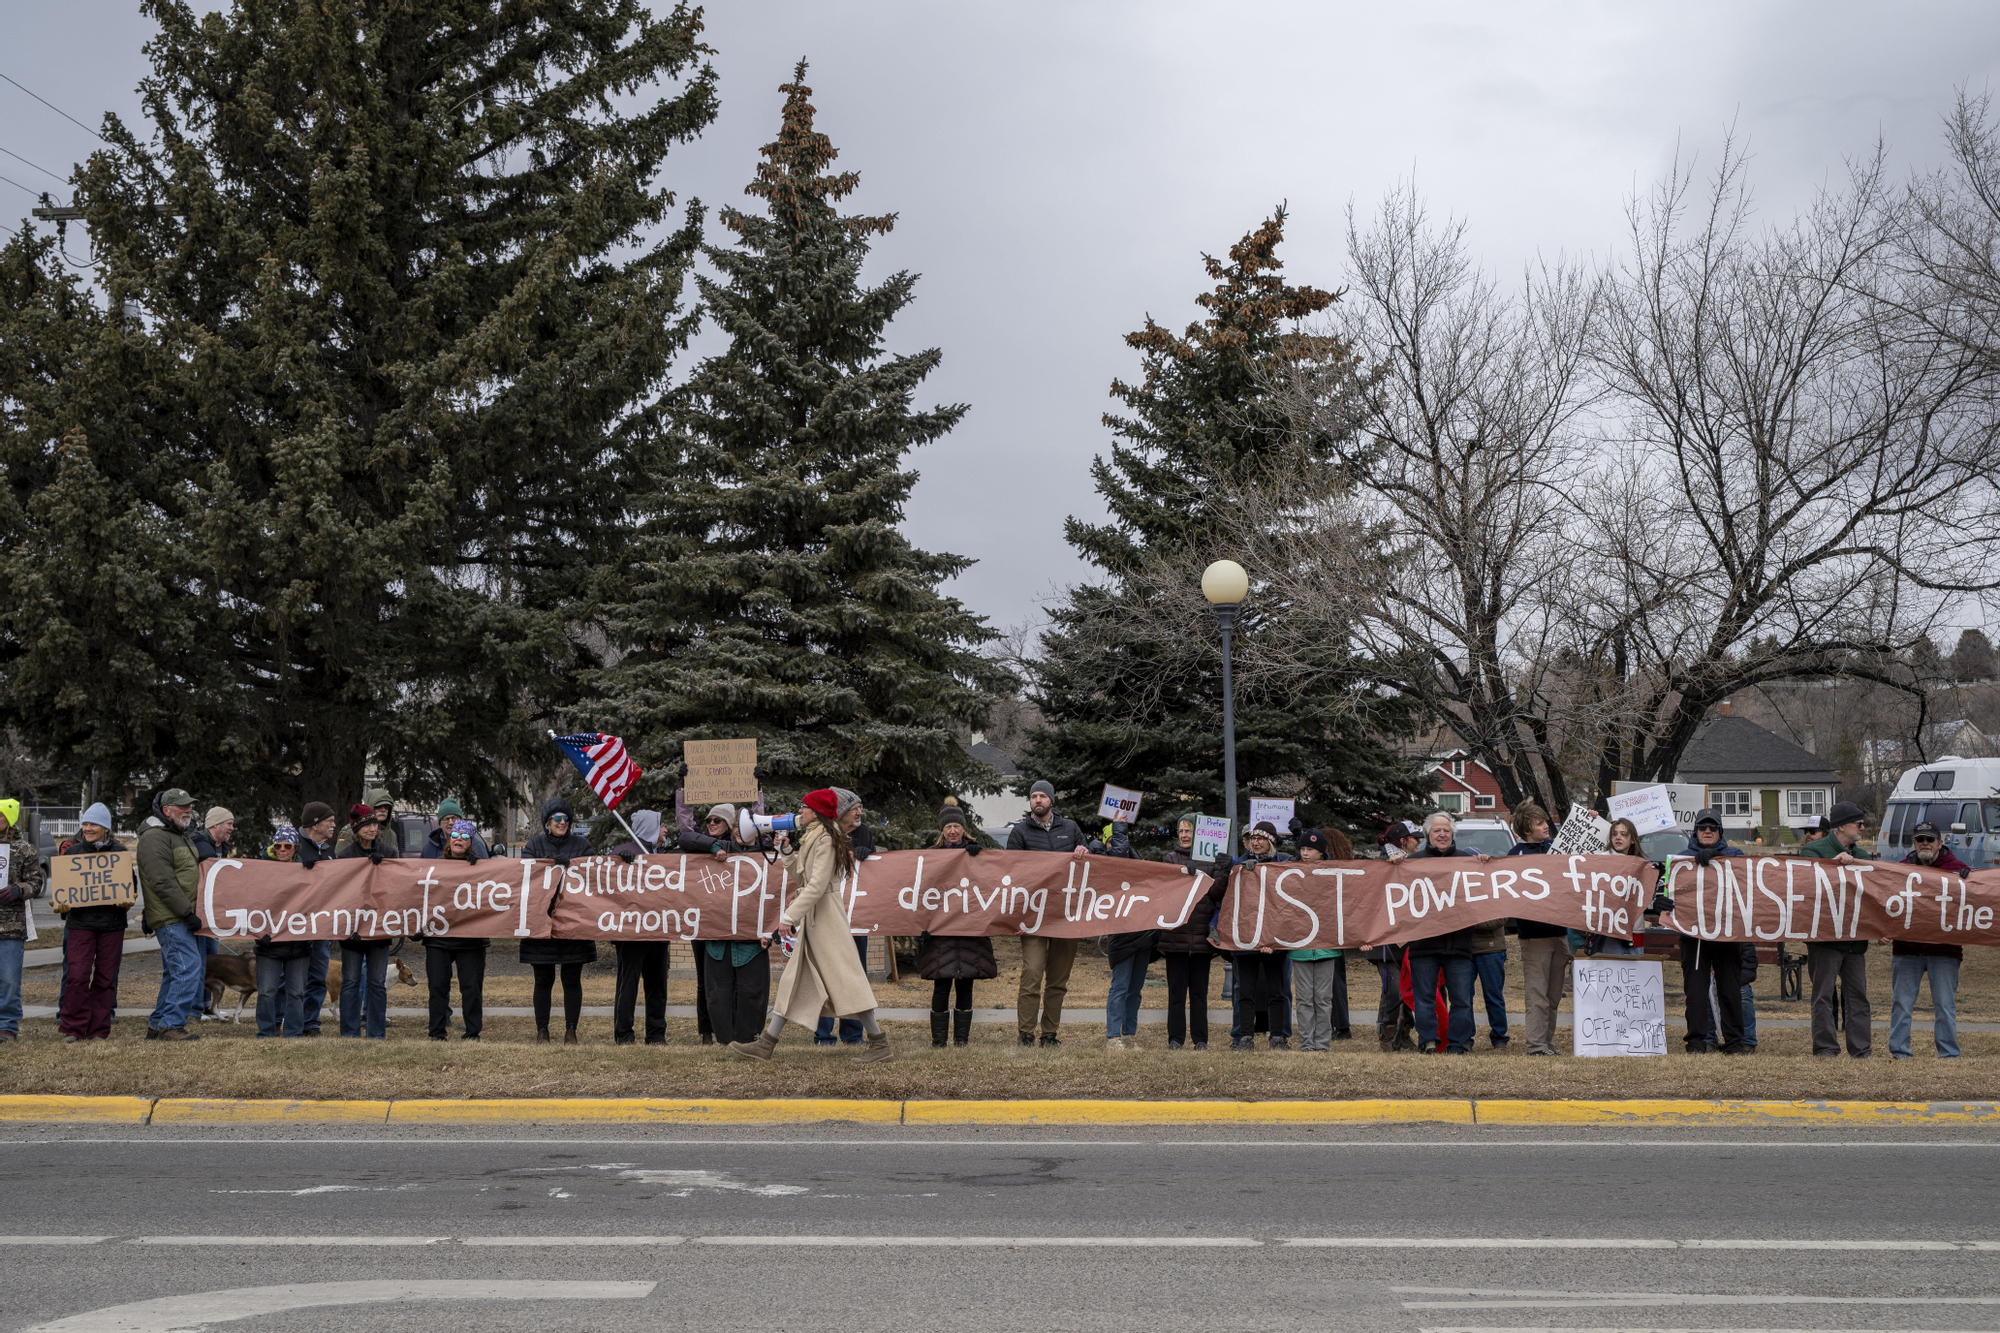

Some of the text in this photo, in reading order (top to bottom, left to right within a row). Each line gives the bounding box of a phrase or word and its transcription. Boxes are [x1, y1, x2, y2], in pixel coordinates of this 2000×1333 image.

[686, 788, 757, 801] ELECTED PRESIDENT?
[1105, 797, 1138, 812] ICE OUT
[1207, 818, 1226, 827] Prefer
[1197, 828, 1228, 838] CRUSHED
[1562, 825, 1581, 842] FACES
[1567, 819, 1606, 851] SHOW THEIR
[1200, 841, 1219, 858] ICE
[70, 854, 121, 871] STOP
[80, 870, 113, 886] THE
[55, 882, 132, 904] CRUELTY
[204, 860, 450, 938] Governments
[454, 881, 511, 912] are
[698, 865, 733, 893] the
[898, 856, 1048, 934] deriving
[1062, 861, 1150, 922] their
[1385, 868, 1550, 926] POWERS
[1562, 855, 1643, 907] from
[1668, 858, 1994, 941] CONSENT of the
[1581, 889, 1629, 935] the
[598, 908, 700, 941] among
[1578, 968, 1636, 983] KEEP ICE
[1625, 985, 1640, 994] THE
[1624, 993, 1656, 1012] PEAK
[1613, 1008, 1629, 1020] and
[1582, 1018, 1611, 1040] OFF
